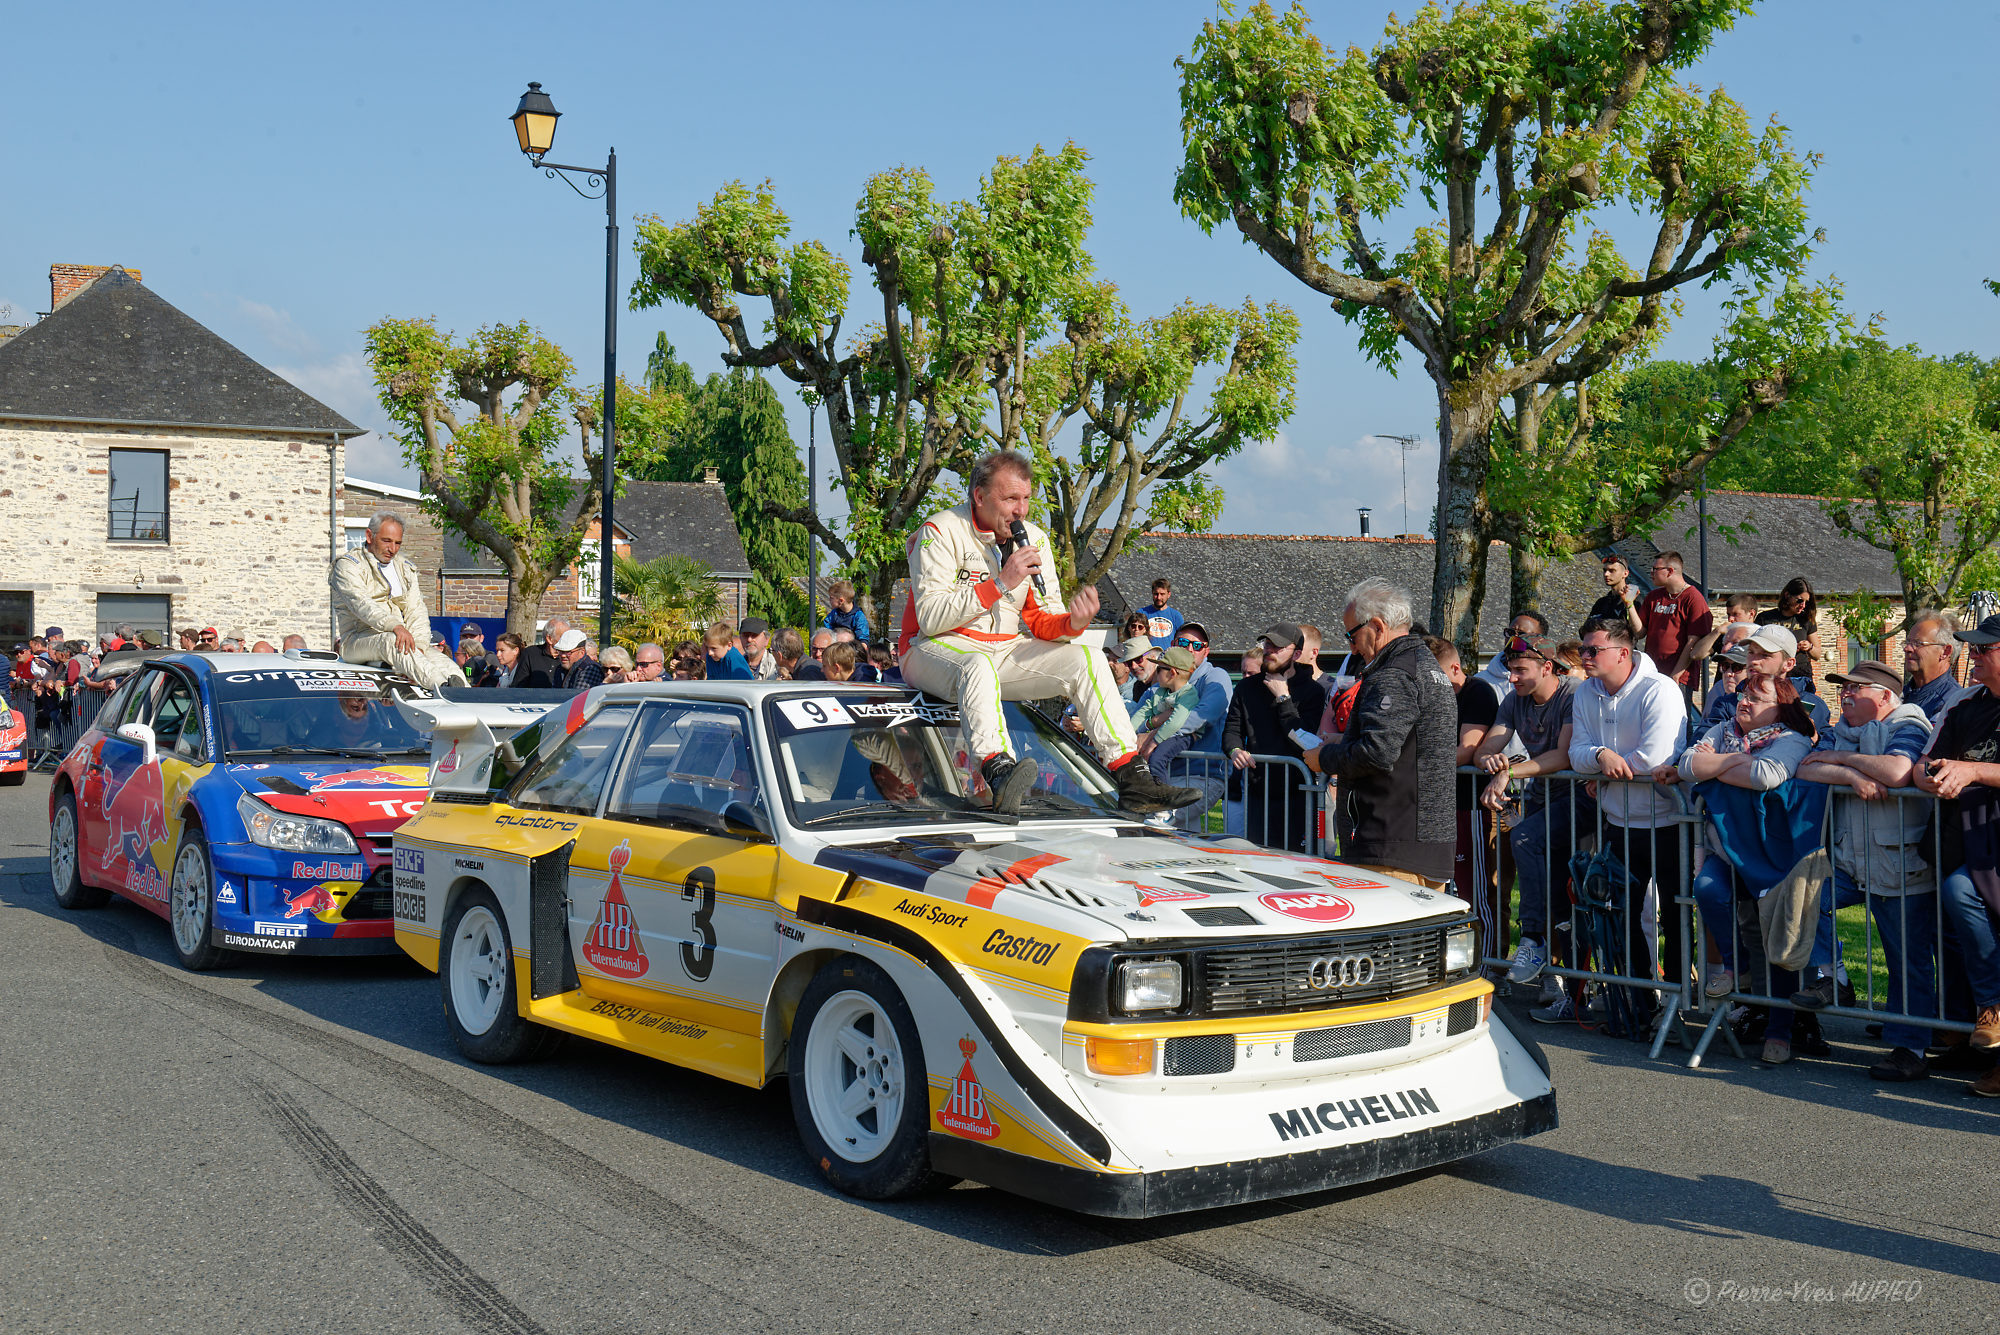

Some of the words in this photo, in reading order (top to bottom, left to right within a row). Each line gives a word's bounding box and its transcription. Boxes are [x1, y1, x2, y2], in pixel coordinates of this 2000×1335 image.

[225, 670, 382, 683] CITROËN
[338, 679, 375, 688] AUTO
[801, 700, 828, 723] 9
[853, 705, 929, 716] Vaison
[125, 730, 145, 740] TOTAL
[495, 815, 578, 832] quattro
[292, 861, 327, 879] Red
[328, 861, 363, 880] Bull
[395, 848, 424, 873] SKF
[454, 858, 484, 871] MICHELIN
[126, 860, 148, 893] Red
[148, 866, 169, 902] Bull
[395, 876, 425, 891] speedline
[395, 892, 425, 921] BOGE
[893, 898, 930, 917] Audi
[926, 906, 968, 928] Sport
[254, 921, 308, 937] PIRELLI
[599, 900, 633, 951] HB
[678, 865, 717, 982] 3
[225, 934, 296, 949] EURODATACAR
[981, 928, 1061, 967] Castrol
[591, 950, 641, 973] international
[590, 1001, 641, 1021] BOSCH
[636, 1012, 661, 1029] fuel
[657, 1017, 708, 1040] injection
[952, 1076, 984, 1120] HB
[944, 1115, 992, 1136] international
[1268, 1087, 1440, 1141] MICHELIN
